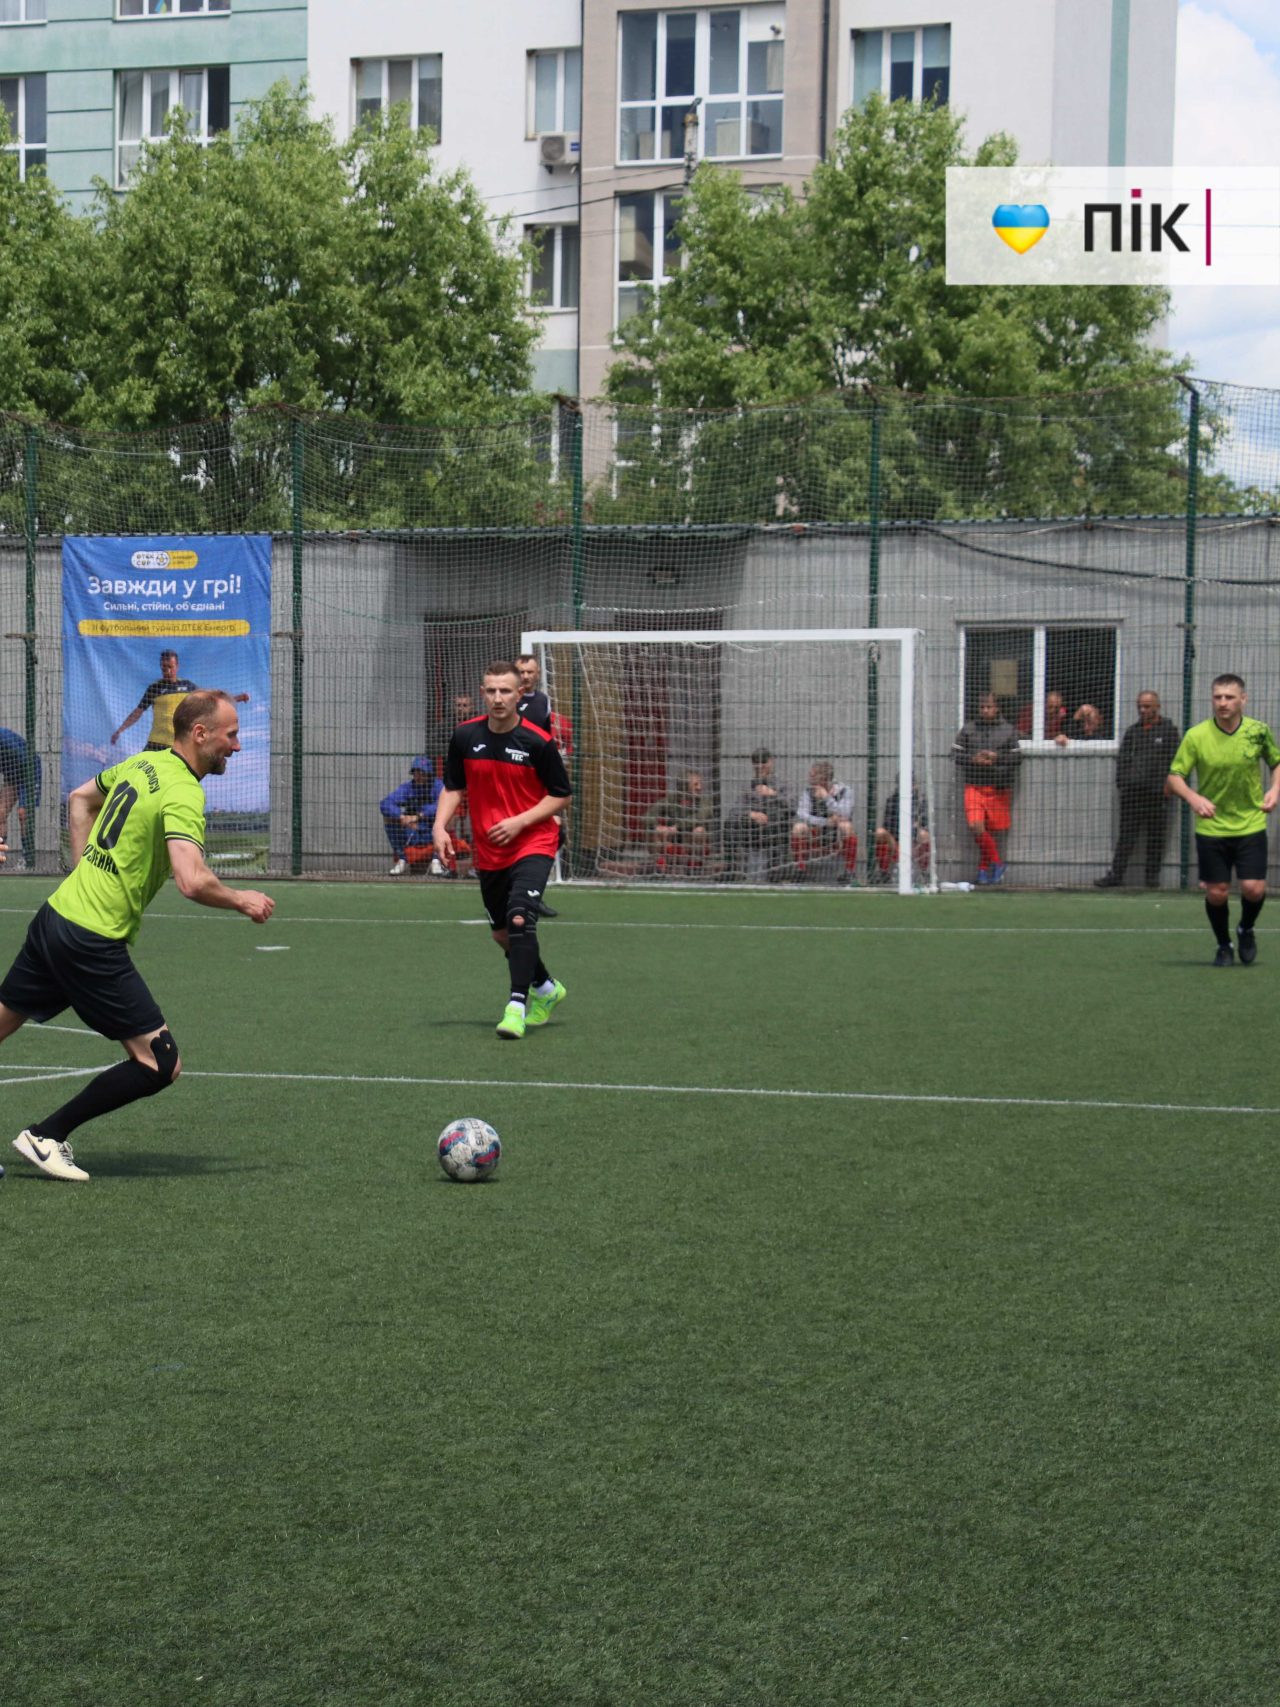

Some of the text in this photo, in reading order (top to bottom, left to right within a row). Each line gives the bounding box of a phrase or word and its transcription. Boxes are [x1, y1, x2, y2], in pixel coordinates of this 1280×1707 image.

[87, 574, 242, 598] Завжди у грі!
[103, 601, 140, 612] Сильні,
